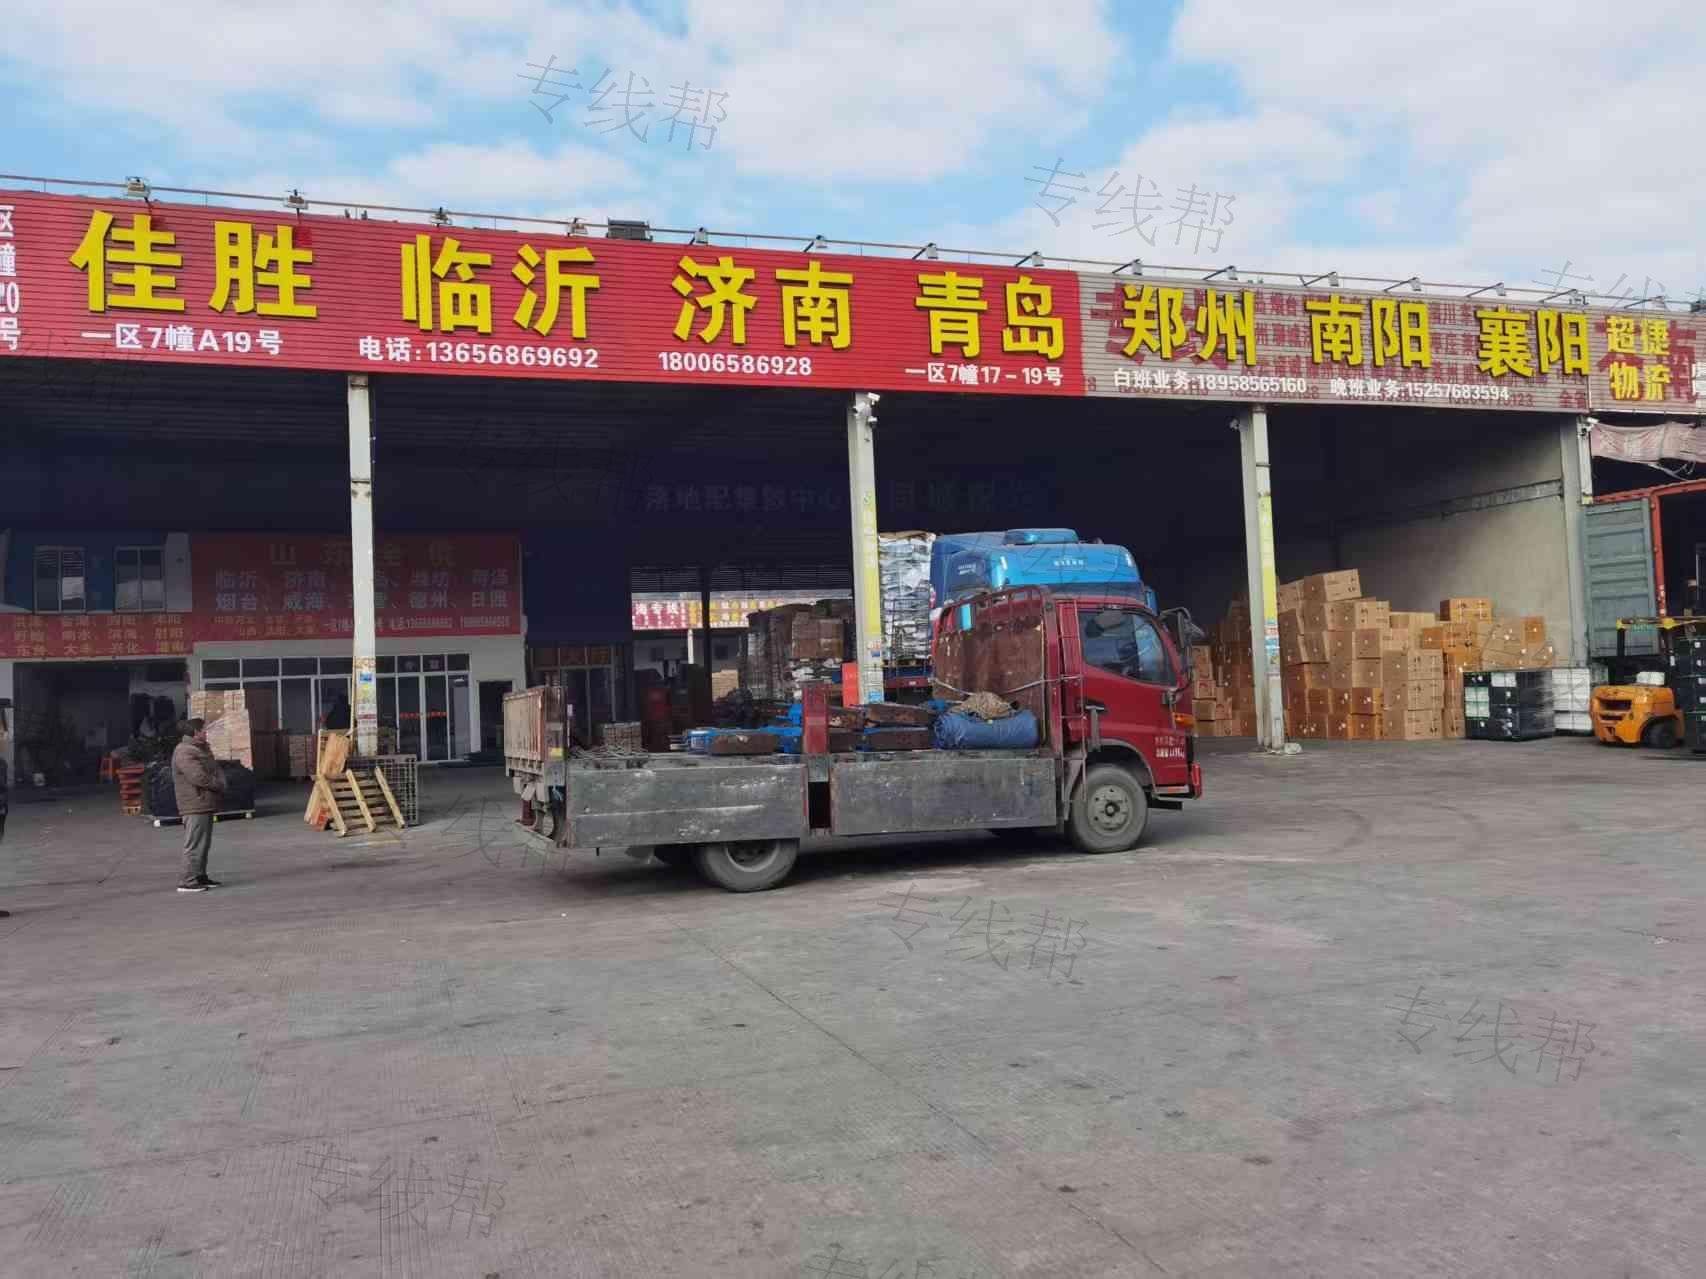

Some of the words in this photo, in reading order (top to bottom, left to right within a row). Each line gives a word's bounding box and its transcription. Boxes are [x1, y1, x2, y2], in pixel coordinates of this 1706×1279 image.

[69, 209, 318, 319] 佳胜
[400, 234, 601, 339] 临沂
[671, 255, 854, 349] 济南
[915, 271, 1064, 359] 青岛
[1121, 284, 1258, 365] 郑州
[1306, 294, 1433, 368] 南阳
[1475, 306, 1590, 377] 襄阳
[1606, 316, 1668, 354] 超捷
[658, 351, 812, 376] 18006586928
[1609, 362, 1670, 400] 物流
